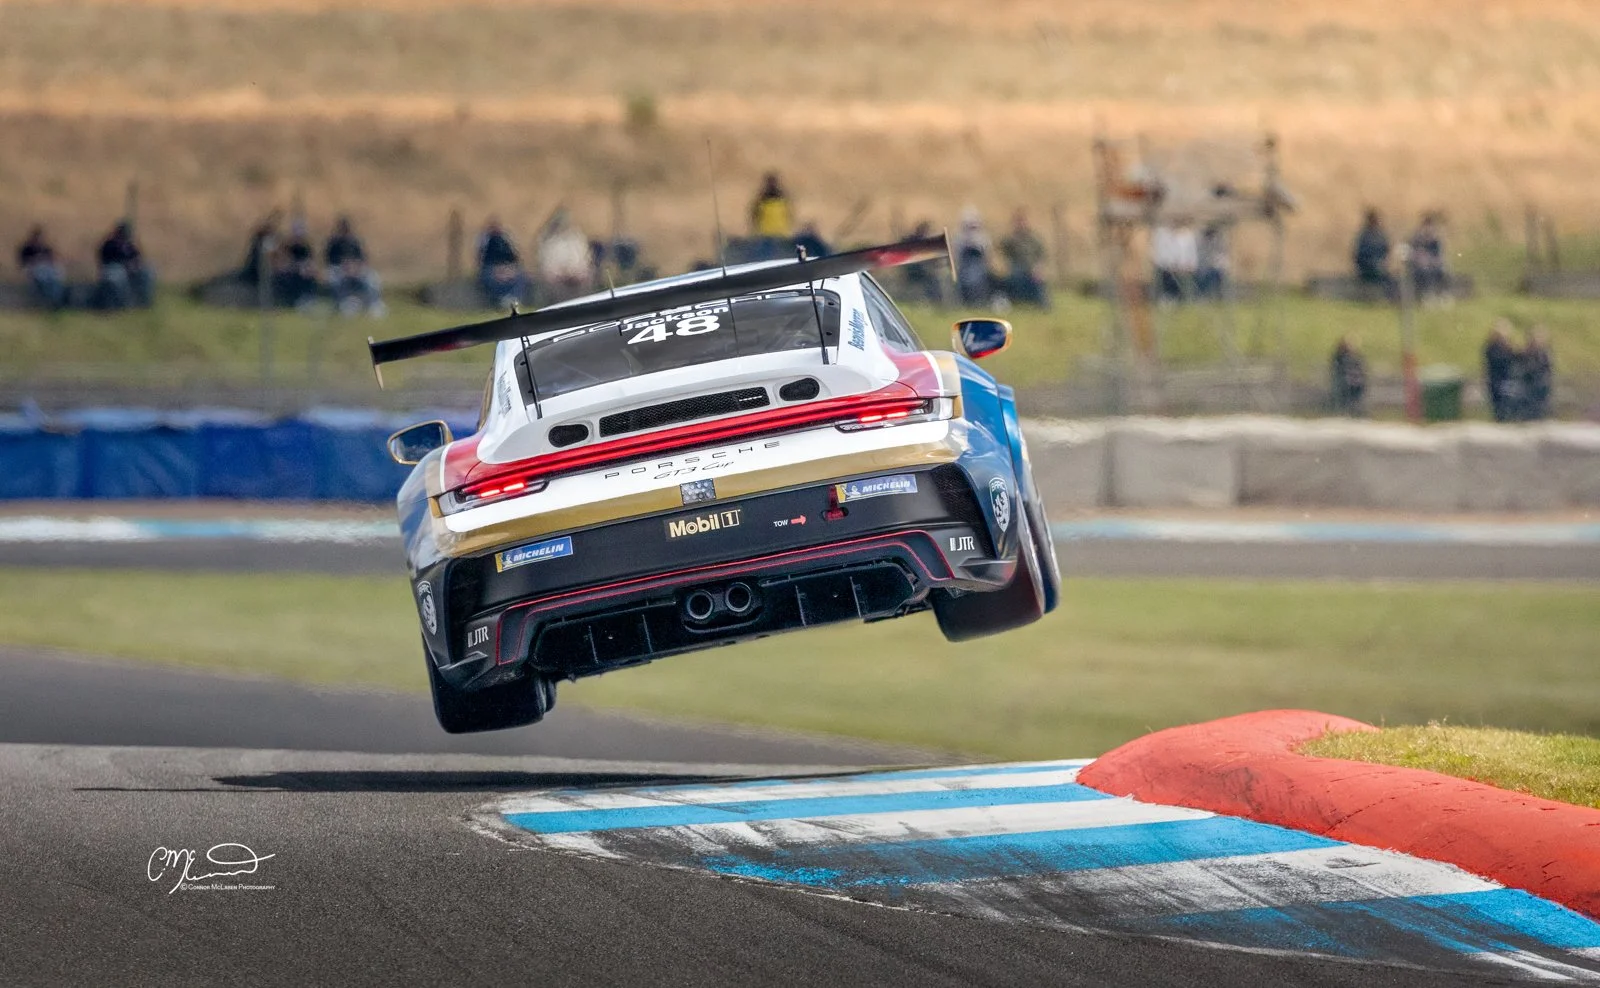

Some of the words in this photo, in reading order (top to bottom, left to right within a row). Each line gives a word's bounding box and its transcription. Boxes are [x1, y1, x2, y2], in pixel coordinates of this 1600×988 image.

[620, 306, 729, 332] Jackson
[627, 314, 720, 345] 48
[604, 440, 780, 480] PORSCHE
[653, 466, 698, 480] GT3
[702, 461, 735, 471] Cup
[862, 480, 911, 493] MICHELIN
[668, 513, 720, 538] Mobil
[773, 519, 789, 528] TOW
[513, 543, 564, 562] MICHELIN
[956, 536, 975, 551] JTR
[473, 625, 489, 646] JTR
